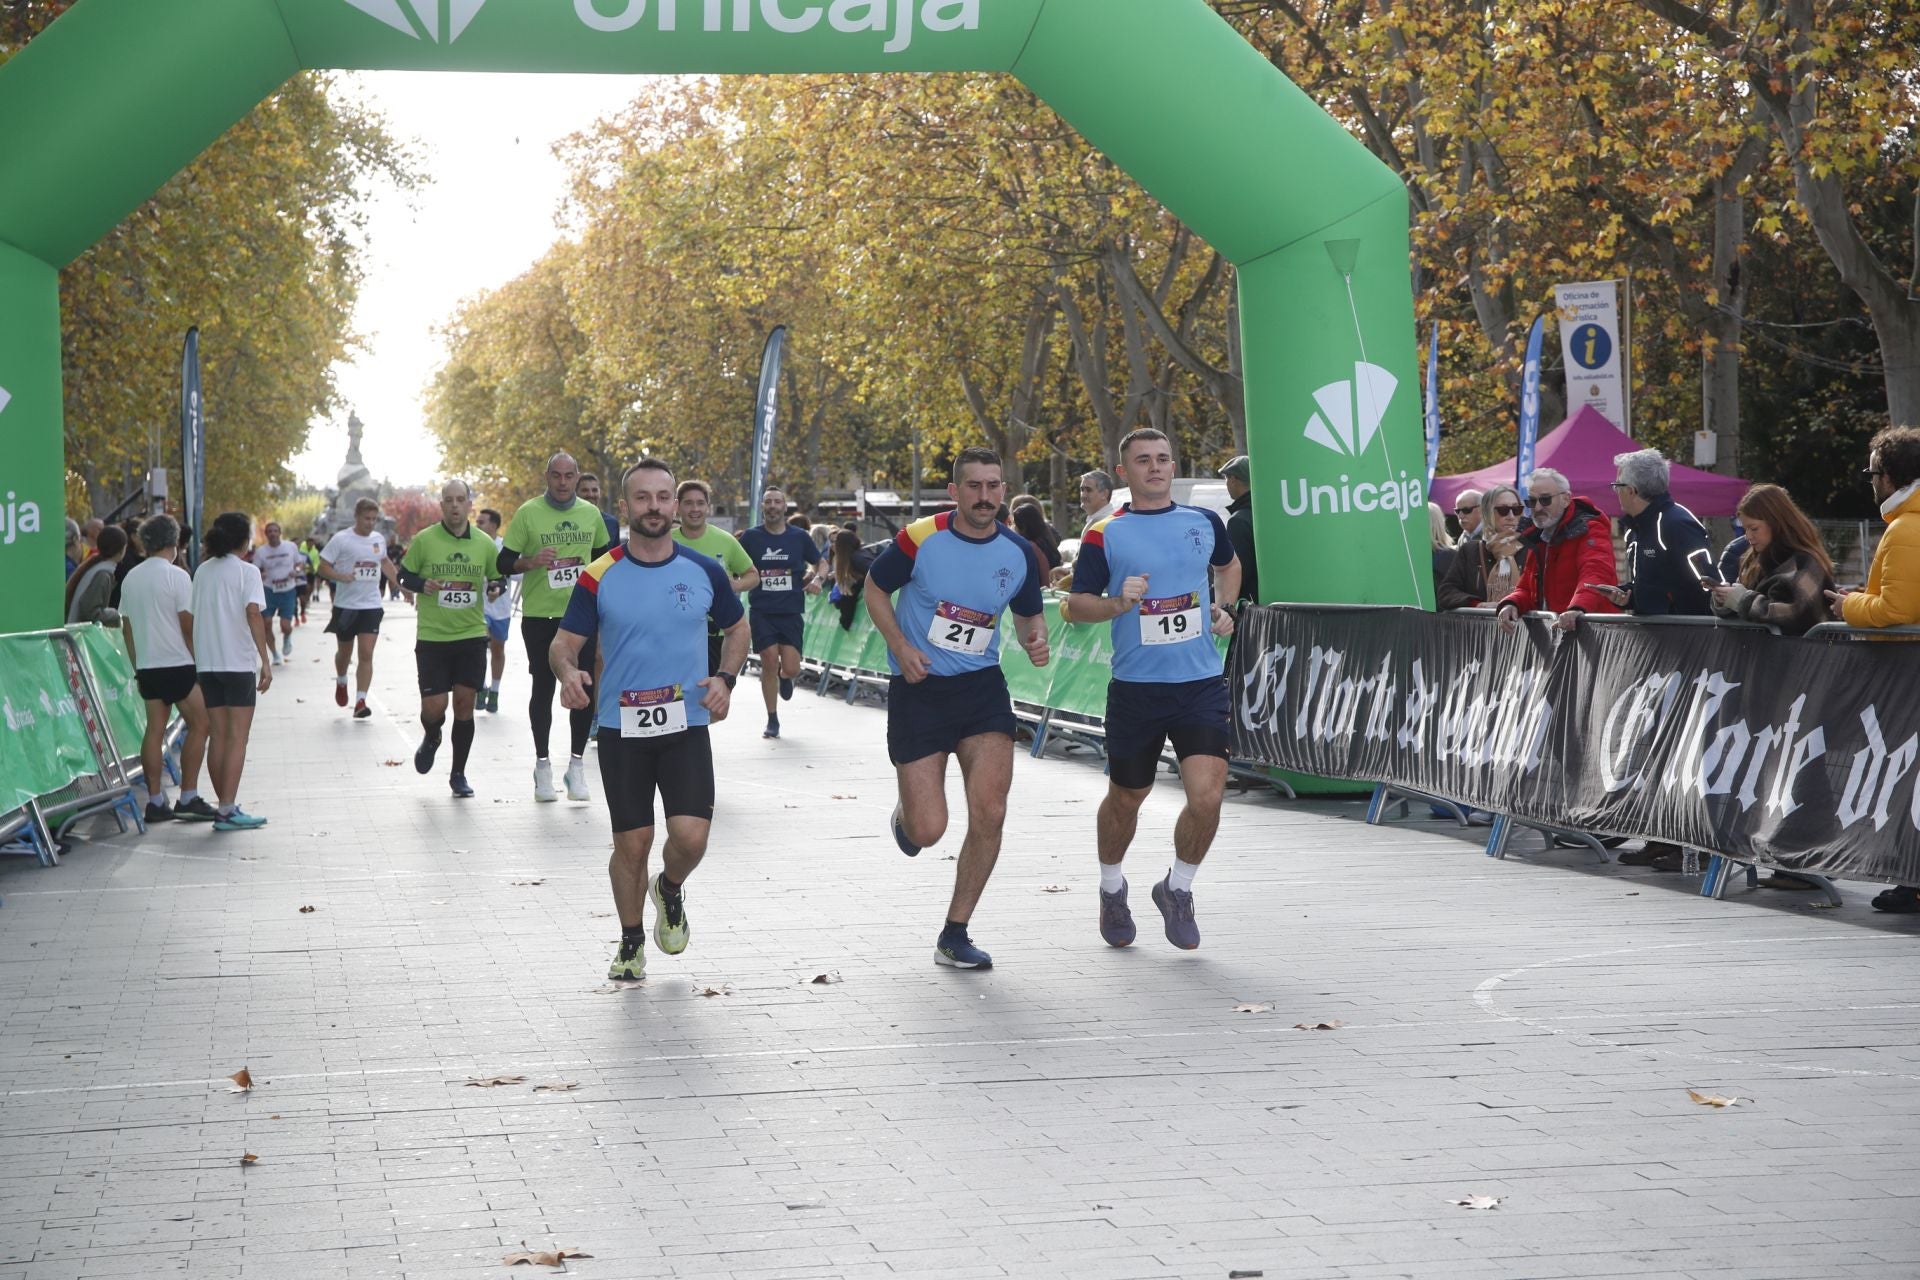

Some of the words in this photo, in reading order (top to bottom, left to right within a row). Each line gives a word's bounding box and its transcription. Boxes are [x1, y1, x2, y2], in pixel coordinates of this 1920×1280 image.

[1562, 292, 1589, 301] Oficina
[1590, 291, 1600, 299] de
[1280, 470, 1423, 520] Unicaja
[0, 490, 40, 545] ja
[359, 568, 378, 577] 172
[554, 567, 580, 582] 451
[765, 576, 788, 588] 644
[443, 592, 471, 604] 453
[945, 623, 976, 646] 21
[1158, 614, 1187, 635] 19
[636, 706, 668, 728] 20
[1600, 670, 1682, 793] El
[1662, 667, 1827, 819] Norte
[1835, 703, 1919, 832] de
